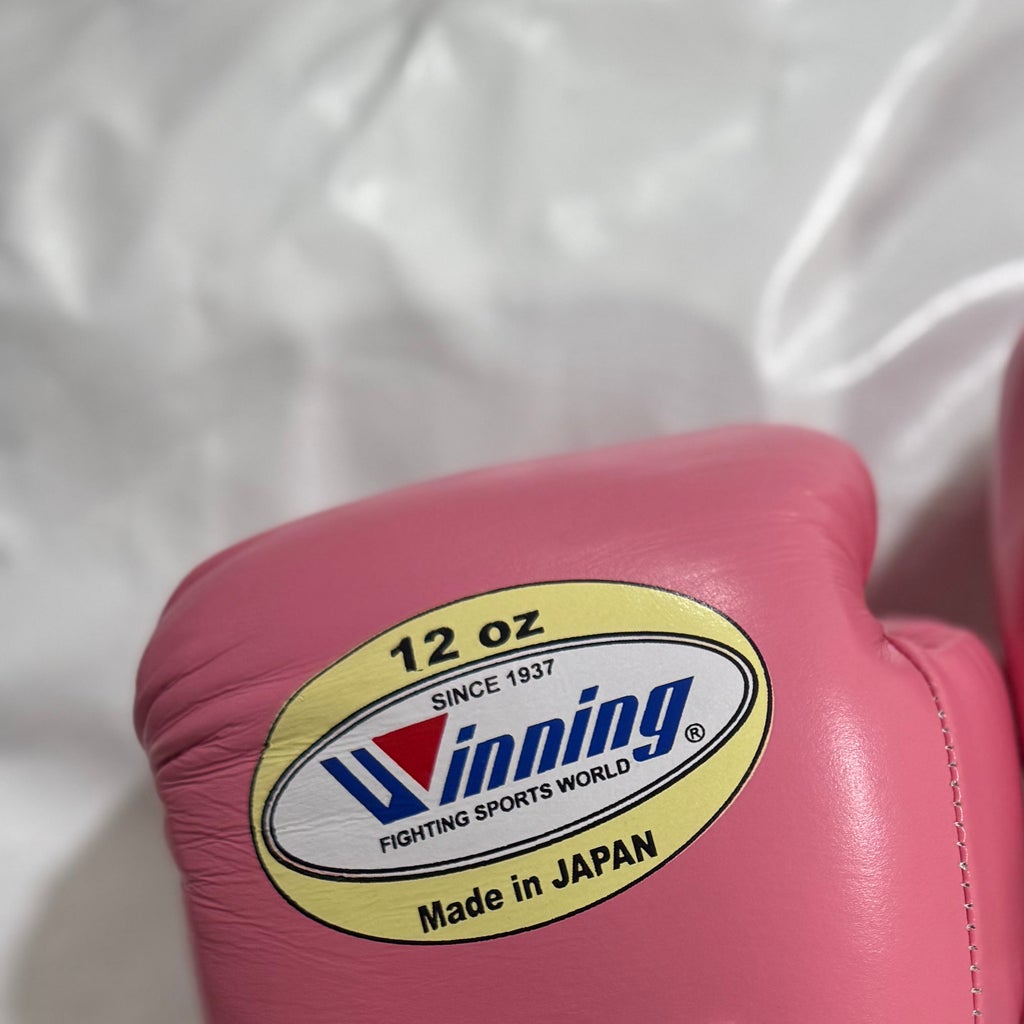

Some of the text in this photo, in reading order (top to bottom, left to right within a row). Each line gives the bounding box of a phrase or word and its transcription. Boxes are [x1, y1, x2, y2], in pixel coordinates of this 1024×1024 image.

[390, 610, 545, 672] 12 oz
[431, 658, 555, 712] SINCE 1937
[320, 676, 695, 826] Winning
[379, 757, 632, 854] FIGHTING SPORTS WORLD
[416, 829, 659, 934] Made in JAPAN
